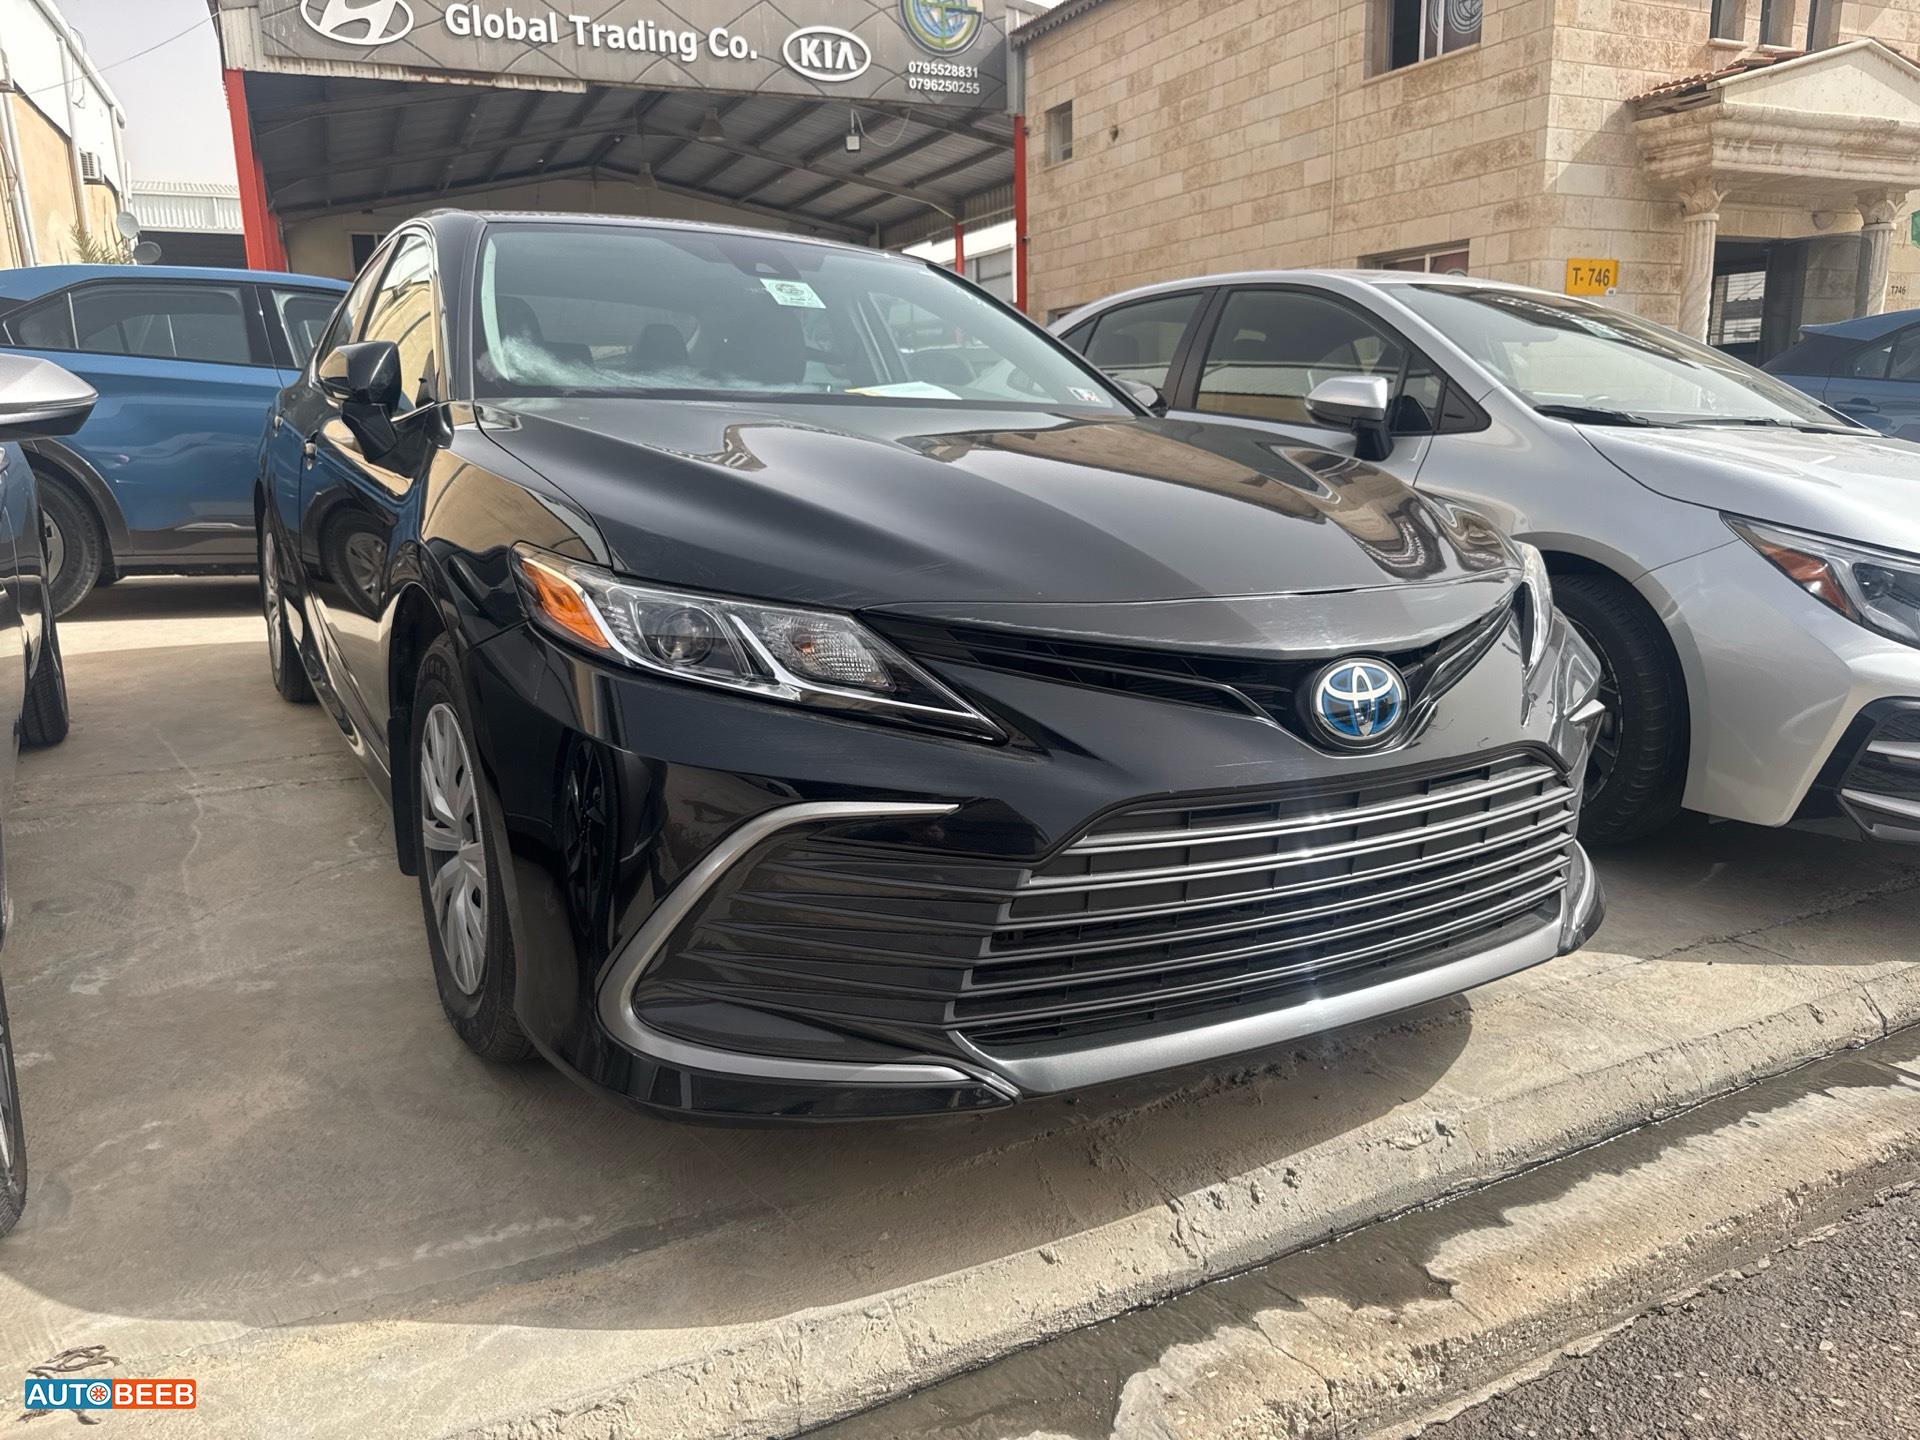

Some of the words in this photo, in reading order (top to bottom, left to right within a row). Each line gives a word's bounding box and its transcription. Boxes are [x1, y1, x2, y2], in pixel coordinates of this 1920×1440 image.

[445, 3, 559, 44] Global
[568, 14, 698, 62] Trading
[708, 27, 758, 60] Co.
[800, 37, 858, 71] KIA
[908, 61, 979, 79] 0795528831
[908, 77, 980, 95] 0796250255
